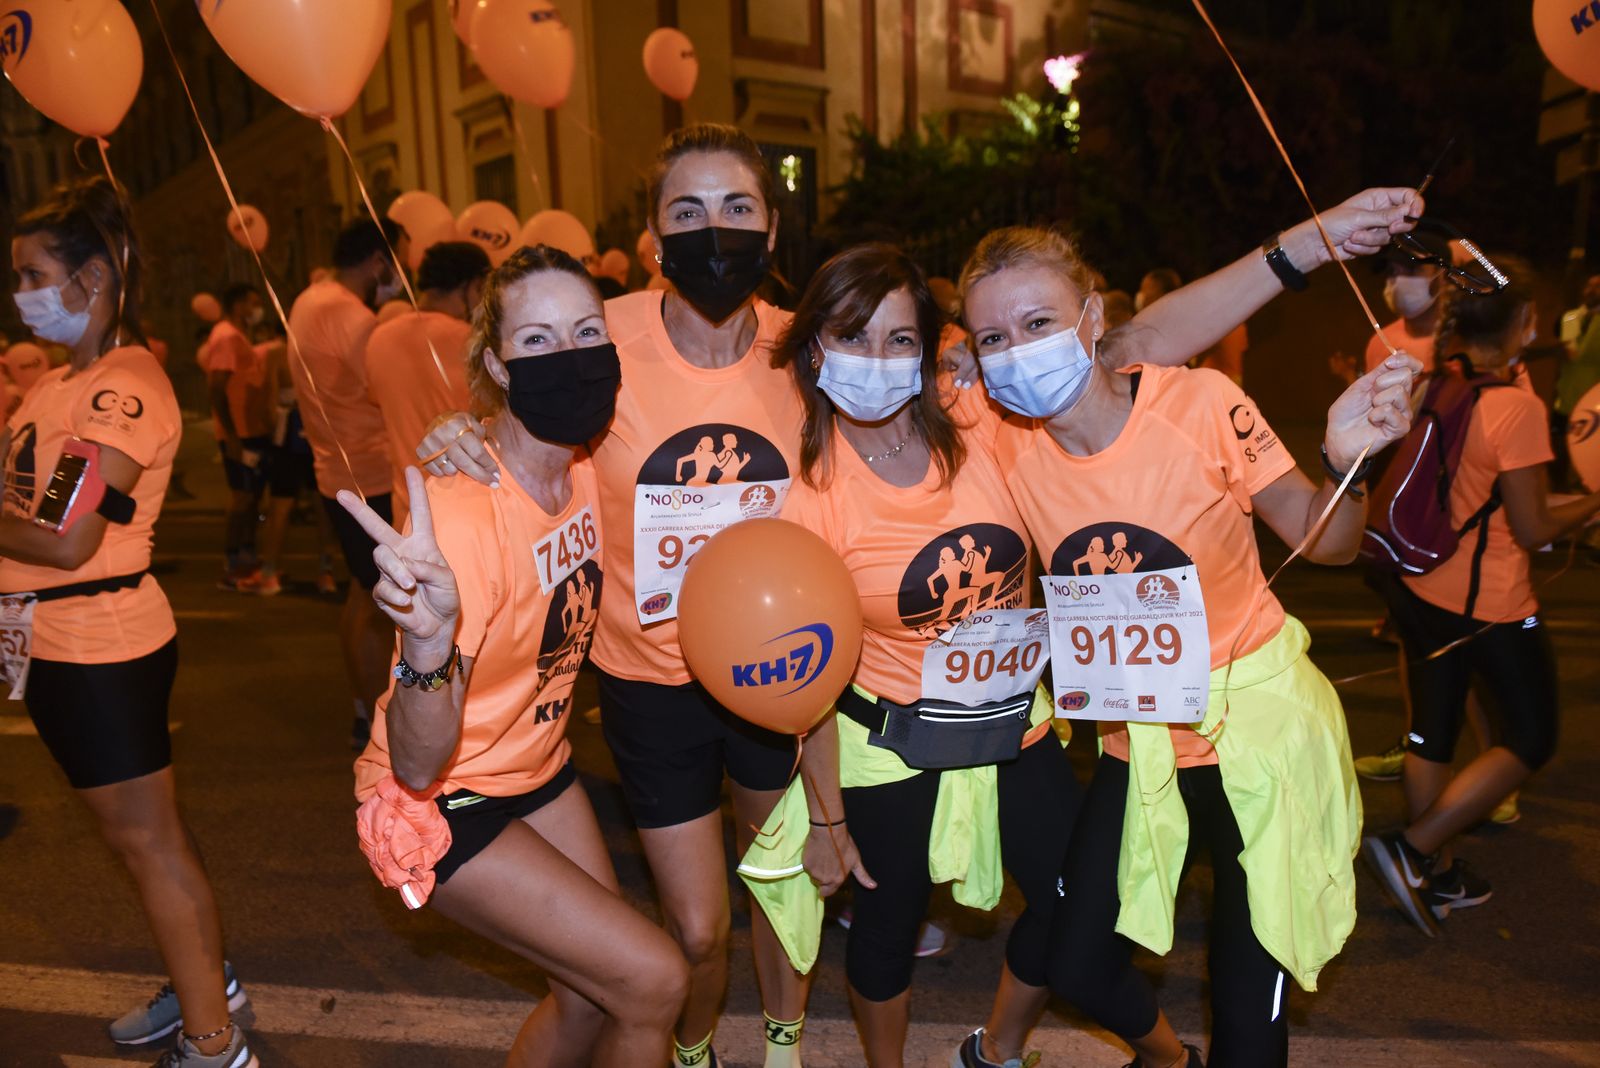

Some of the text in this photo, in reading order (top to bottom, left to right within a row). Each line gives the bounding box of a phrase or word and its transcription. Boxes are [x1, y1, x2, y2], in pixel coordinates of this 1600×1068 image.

[537, 512, 596, 584] 7436
[1067, 614, 1090, 622] CARRERA
[1090, 613, 1119, 621] NOCTURNA
[1130, 612, 1174, 620] GUADALQUIVIR
[945, 641, 1042, 684] 9040
[1071, 623, 1183, 666] 9129
[1184, 696, 1200, 704] ABC
